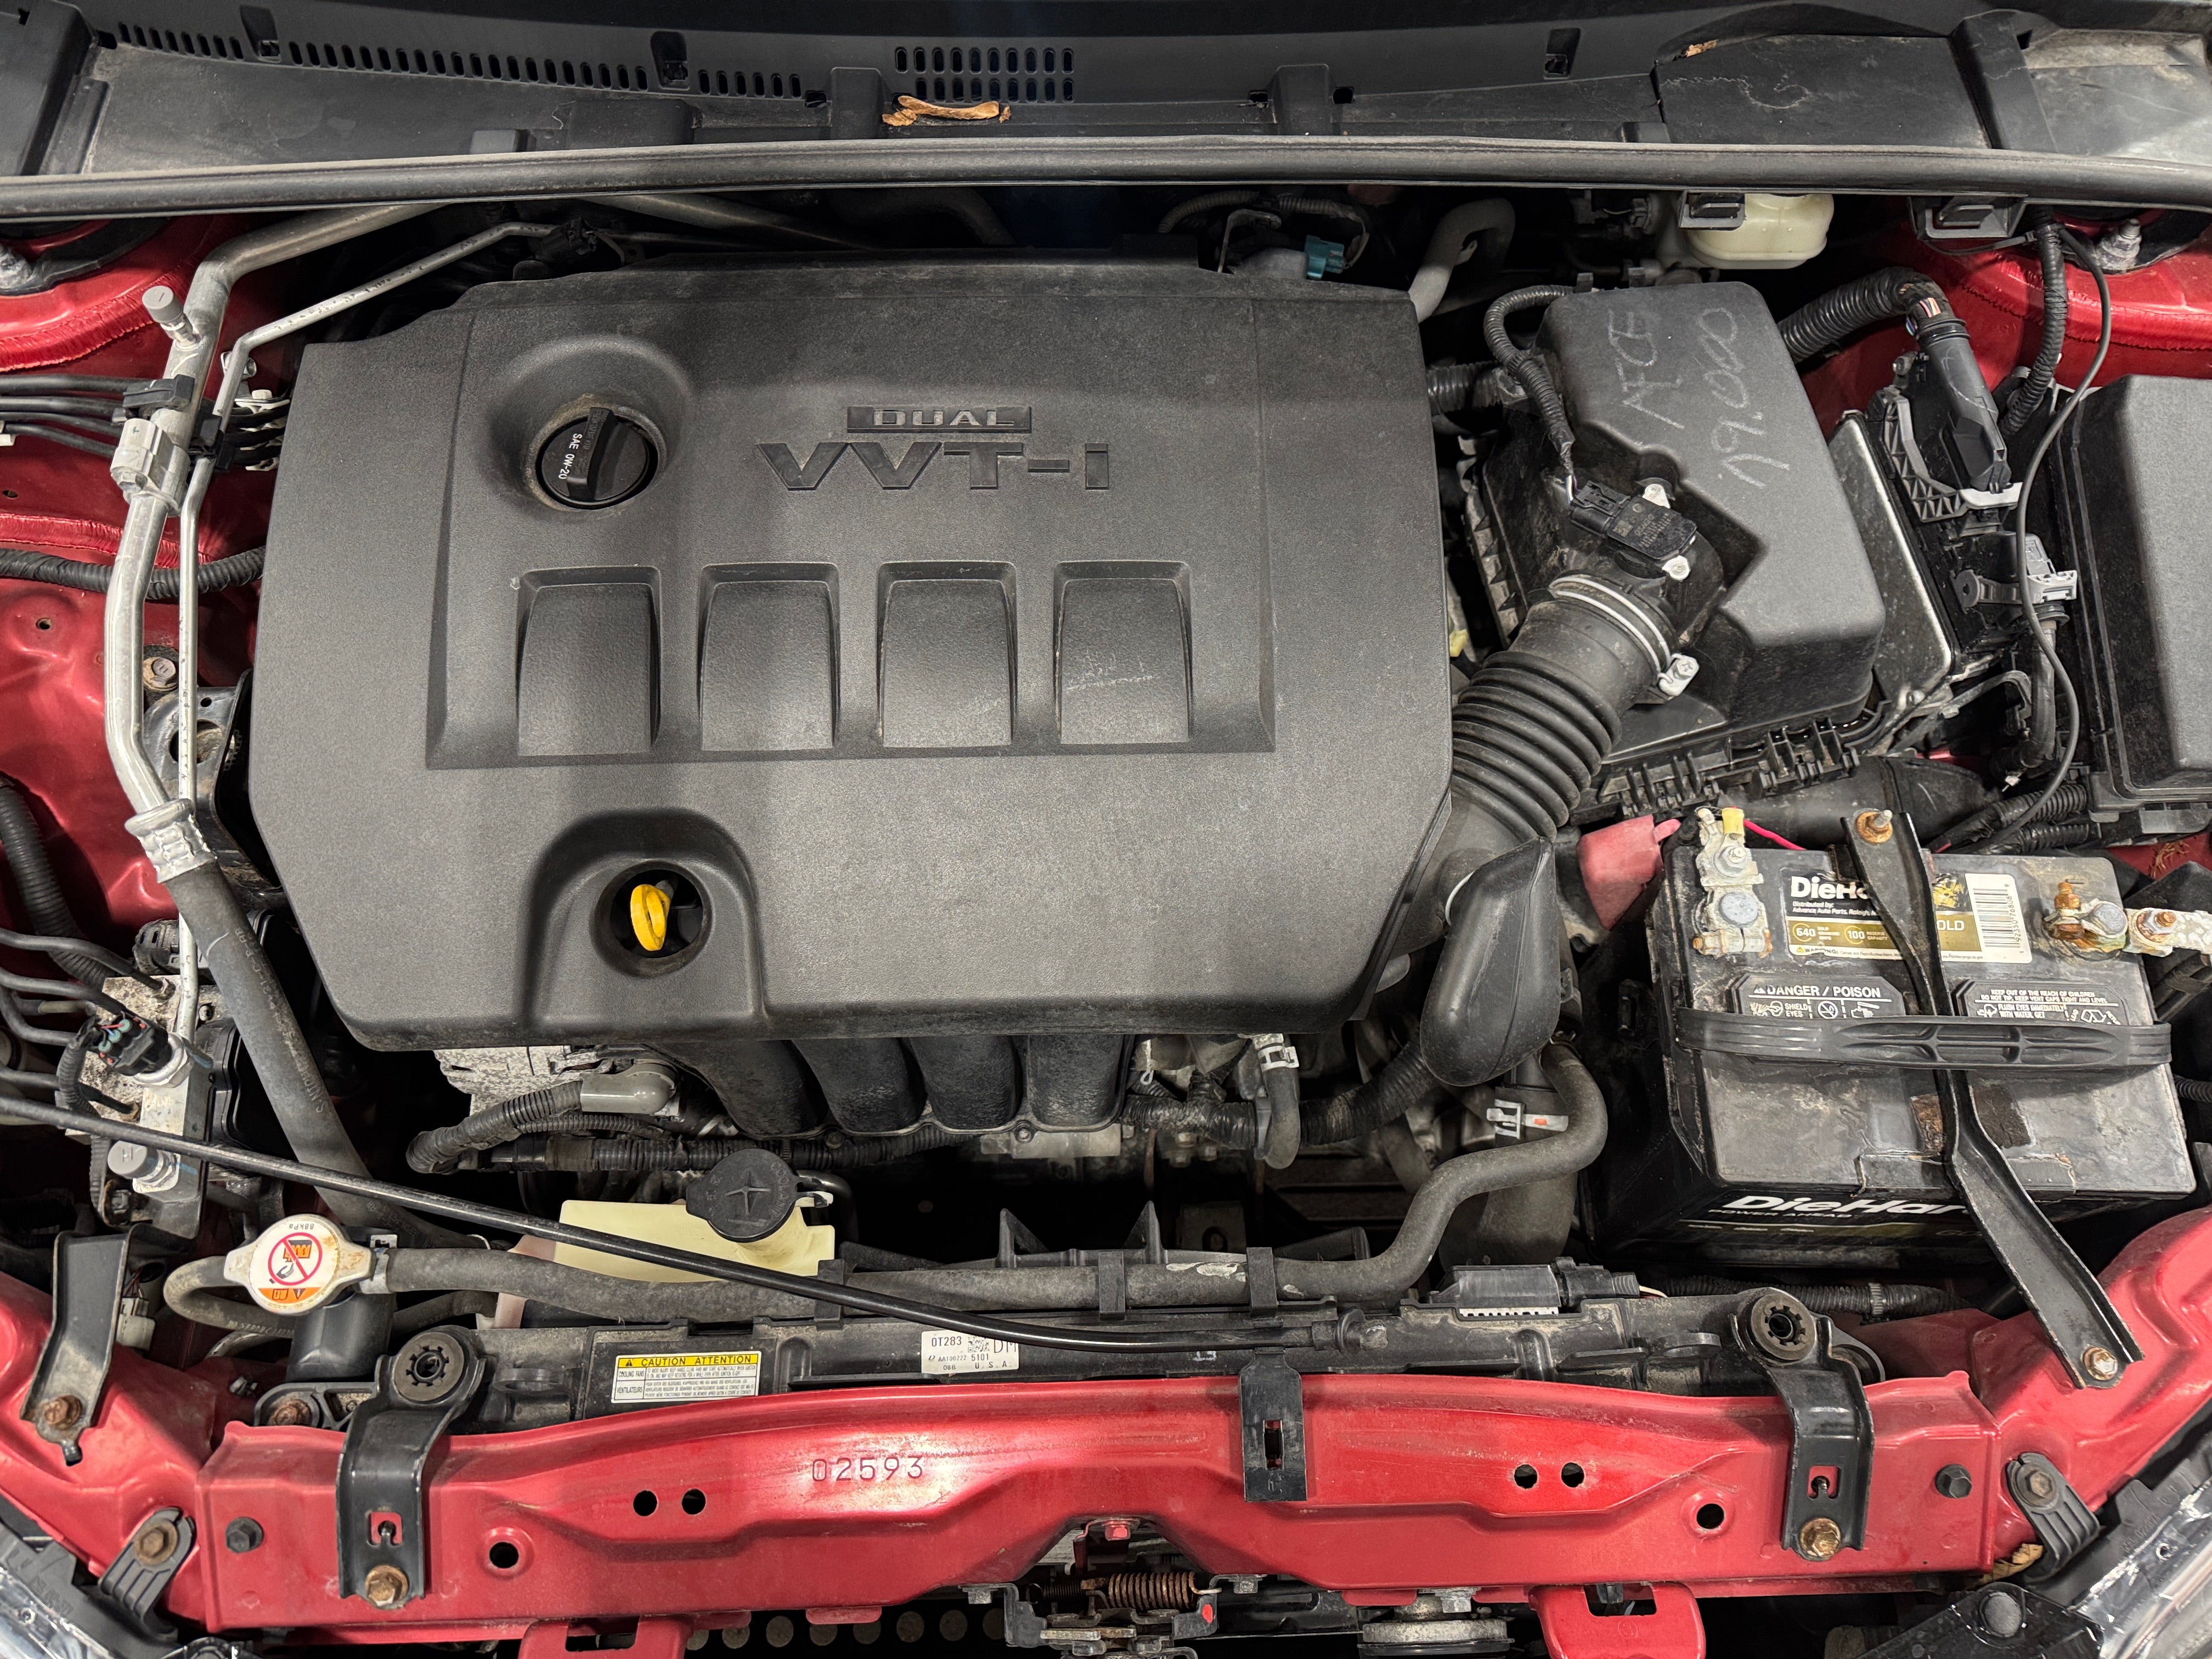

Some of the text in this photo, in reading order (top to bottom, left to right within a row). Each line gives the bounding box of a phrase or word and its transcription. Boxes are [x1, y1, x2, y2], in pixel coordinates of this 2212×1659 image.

[873, 409, 1015, 426] DUAL
[558, 433, 583, 479] SAE 0W-20
[1936, 919, 1965, 931] OLD
[1796, 928, 1816, 937] 640
[1847, 930, 1865, 940] 100
[1767, 985, 1881, 998] DANGER / POISON
[1784, 1003, 1808, 1011] SHIELD
[771, 1160, 791, 1217] COOLANT
[1723, 1195, 1973, 1215] DieHar
[1708, 1209, 1779, 1217] POWER
[641, 1355, 751, 1367] CAUTION ATTENTION
[812, 1455, 923, 1481] 02593
